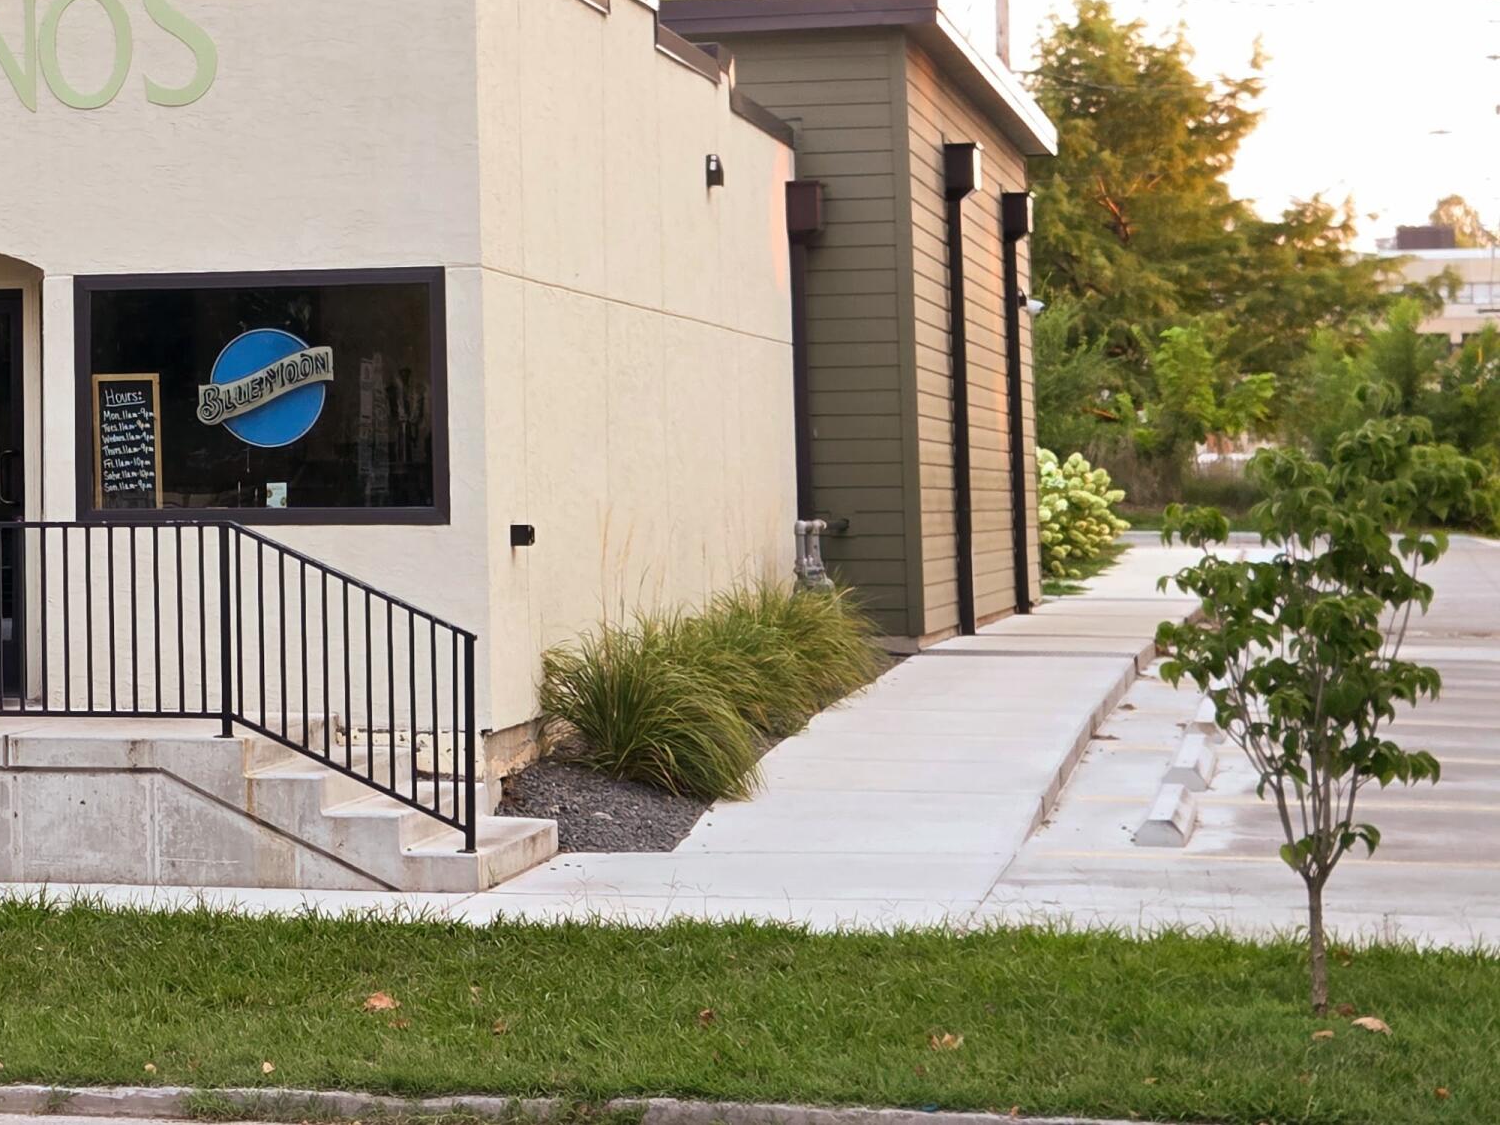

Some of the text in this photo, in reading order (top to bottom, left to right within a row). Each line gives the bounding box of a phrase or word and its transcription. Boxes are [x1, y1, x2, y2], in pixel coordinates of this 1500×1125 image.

[105, 388, 142, 405] Hours:
[201, 351, 332, 421] BLUE MOON
